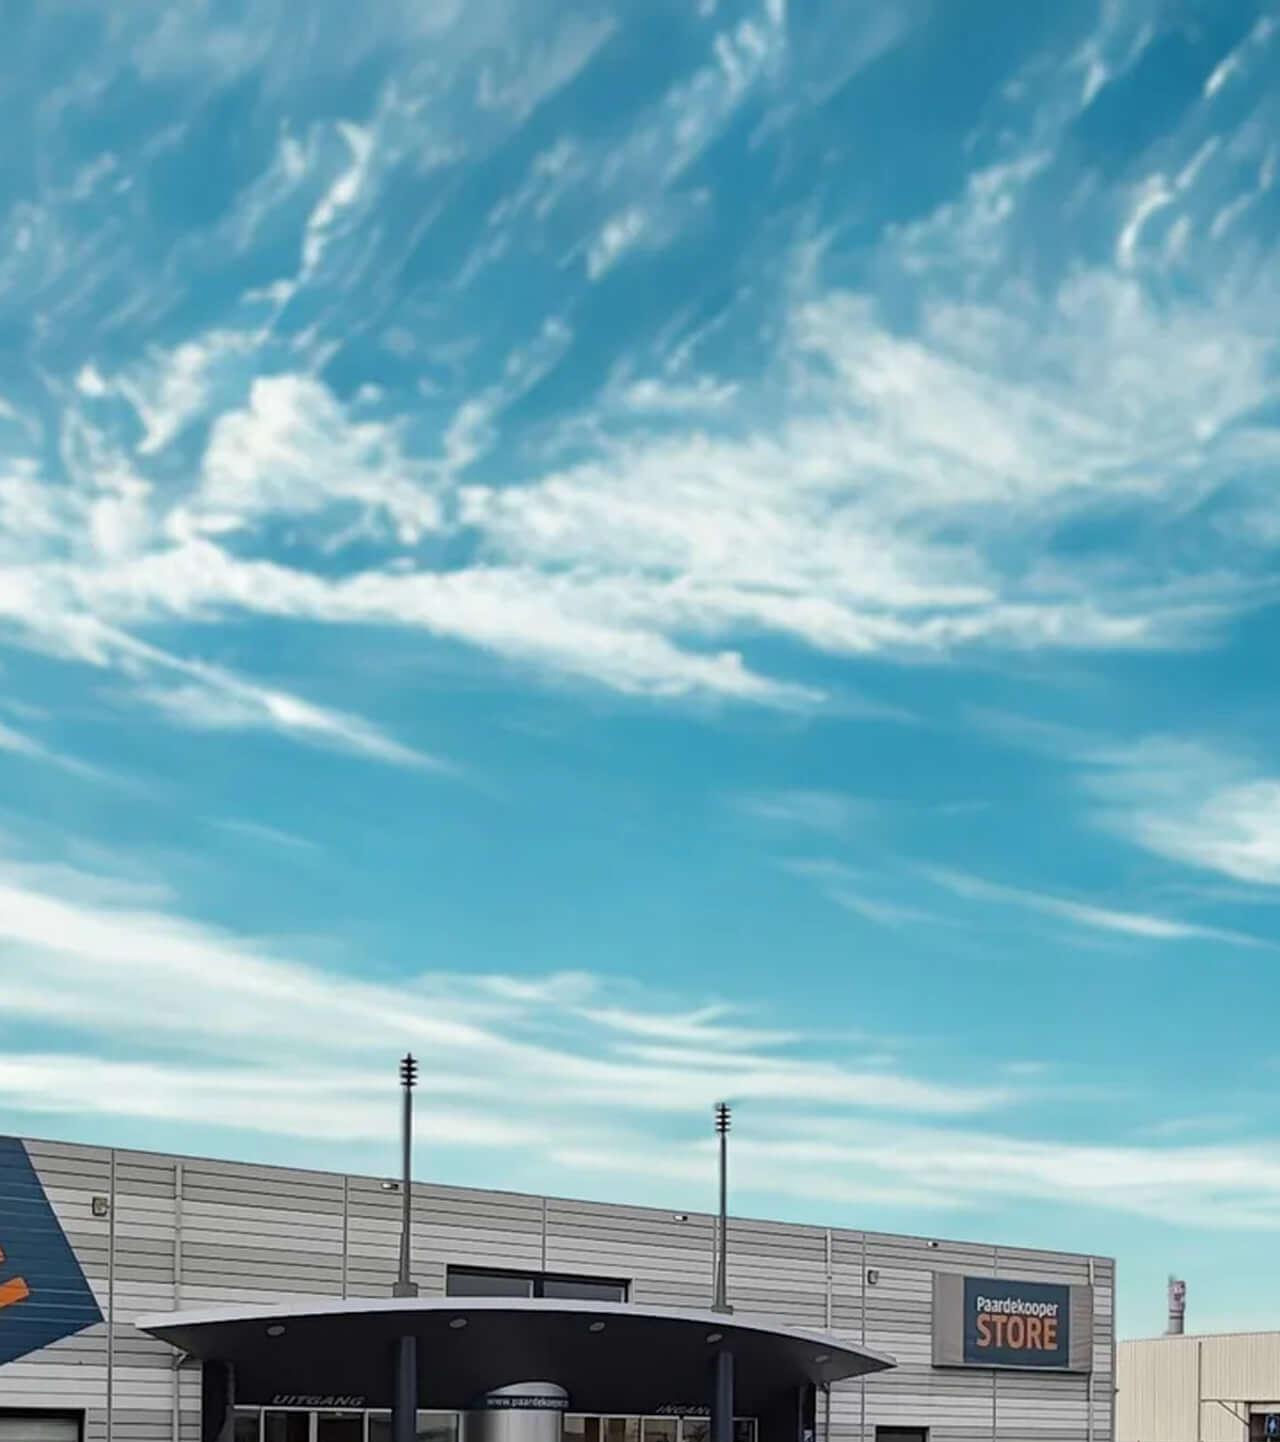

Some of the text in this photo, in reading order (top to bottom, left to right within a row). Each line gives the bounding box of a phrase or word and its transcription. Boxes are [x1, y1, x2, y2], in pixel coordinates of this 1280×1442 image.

[977, 1295, 1059, 1318] Paardekooper
[976, 1313, 1059, 1350] STORE
[272, 1394, 366, 1406] UITGANG
